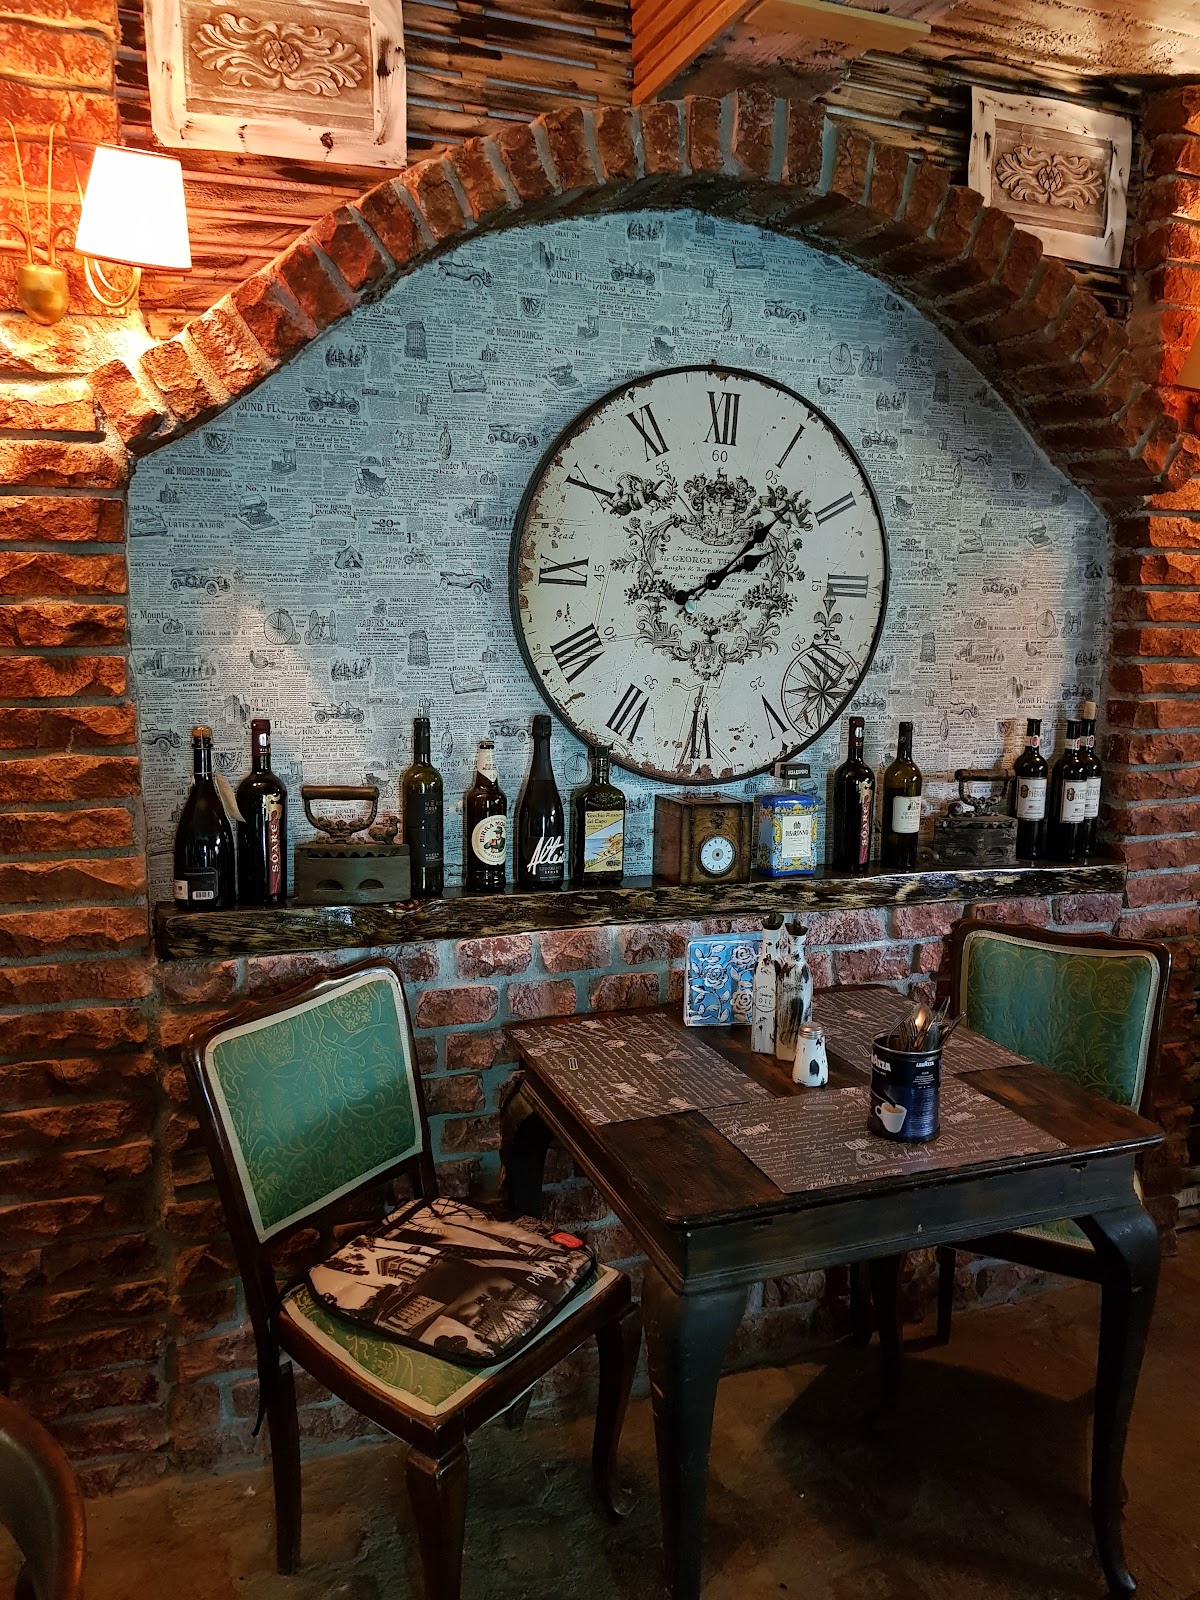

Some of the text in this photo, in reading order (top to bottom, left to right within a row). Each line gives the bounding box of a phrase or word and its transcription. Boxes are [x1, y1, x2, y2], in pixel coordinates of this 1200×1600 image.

[547, 270, 572, 280] OUND
[647, 289, 662, 297] Inch
[496, 327, 521, 339] MODERN
[236, 401, 263, 412] OUND
[286, 415, 314, 424] 1/1000
[331, 418, 345, 426] An
[349, 419, 369, 427] Inch
[703, 391, 741, 446] XII
[625, 402, 670, 462] XI
[775, 423, 805, 468] I
[711, 449, 729, 463] 60
[176, 466, 205, 477] MODERN
[655, 460, 670, 477] 55
[765, 469, 780, 486] 05
[245, 484, 260, 493] No.
[565, 461, 618, 512] X
[330, 504, 352, 512] HEALTH
[814, 491, 857, 526] II
[199, 522, 225, 530] MAJORS
[379, 518, 394, 528] 20
[672, 555, 713, 565] GEORGE
[338, 571, 361, 579] $3.96
[538, 554, 589, 587] IX
[593, 564, 606, 582] 45
[811, 578, 823, 593] 15
[603, 626, 617, 642] 40
[791, 633, 806, 652] 20
[550, 623, 606, 684] VIII
[644, 674, 659, 691] 35
[749, 675, 766, 692] 25
[605, 683, 649, 744] VII
[761, 694, 790, 741] V
[354, 727, 374, 735] Inch
[480, 823, 495, 843] BIRRA
[526, 1260, 556, 1287] PARIS
